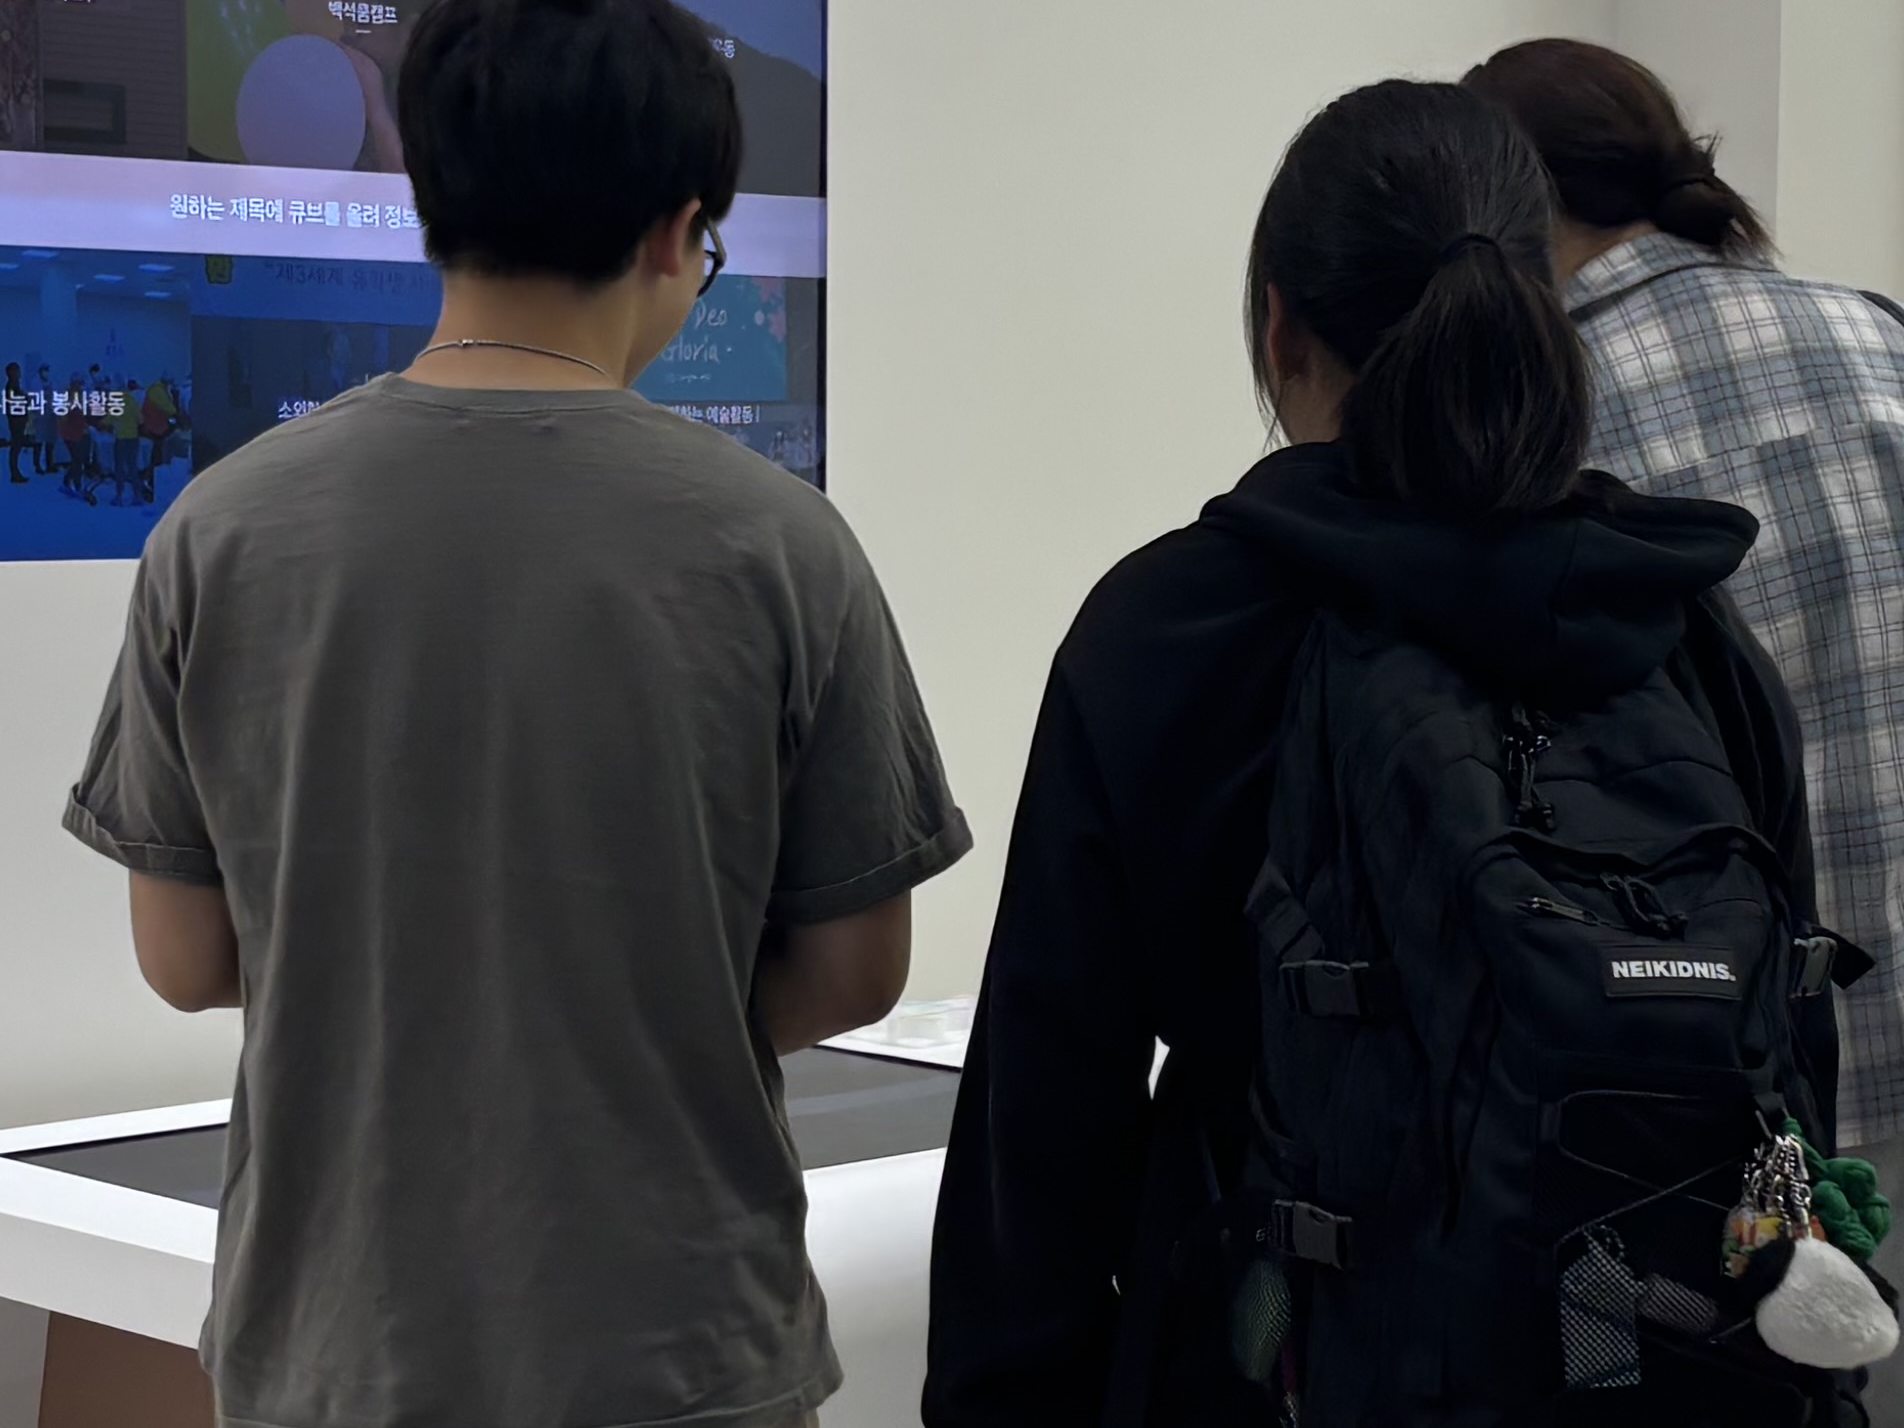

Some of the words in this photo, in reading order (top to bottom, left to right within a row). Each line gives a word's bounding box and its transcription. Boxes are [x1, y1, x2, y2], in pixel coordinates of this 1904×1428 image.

[169, 194, 225, 221] 원하는
[230, 197, 283, 223] 제목에
[288, 200, 341, 227] 큐브를
[346, 203, 380, 228] 올려
[52, 391, 126, 417] 봉사활동
